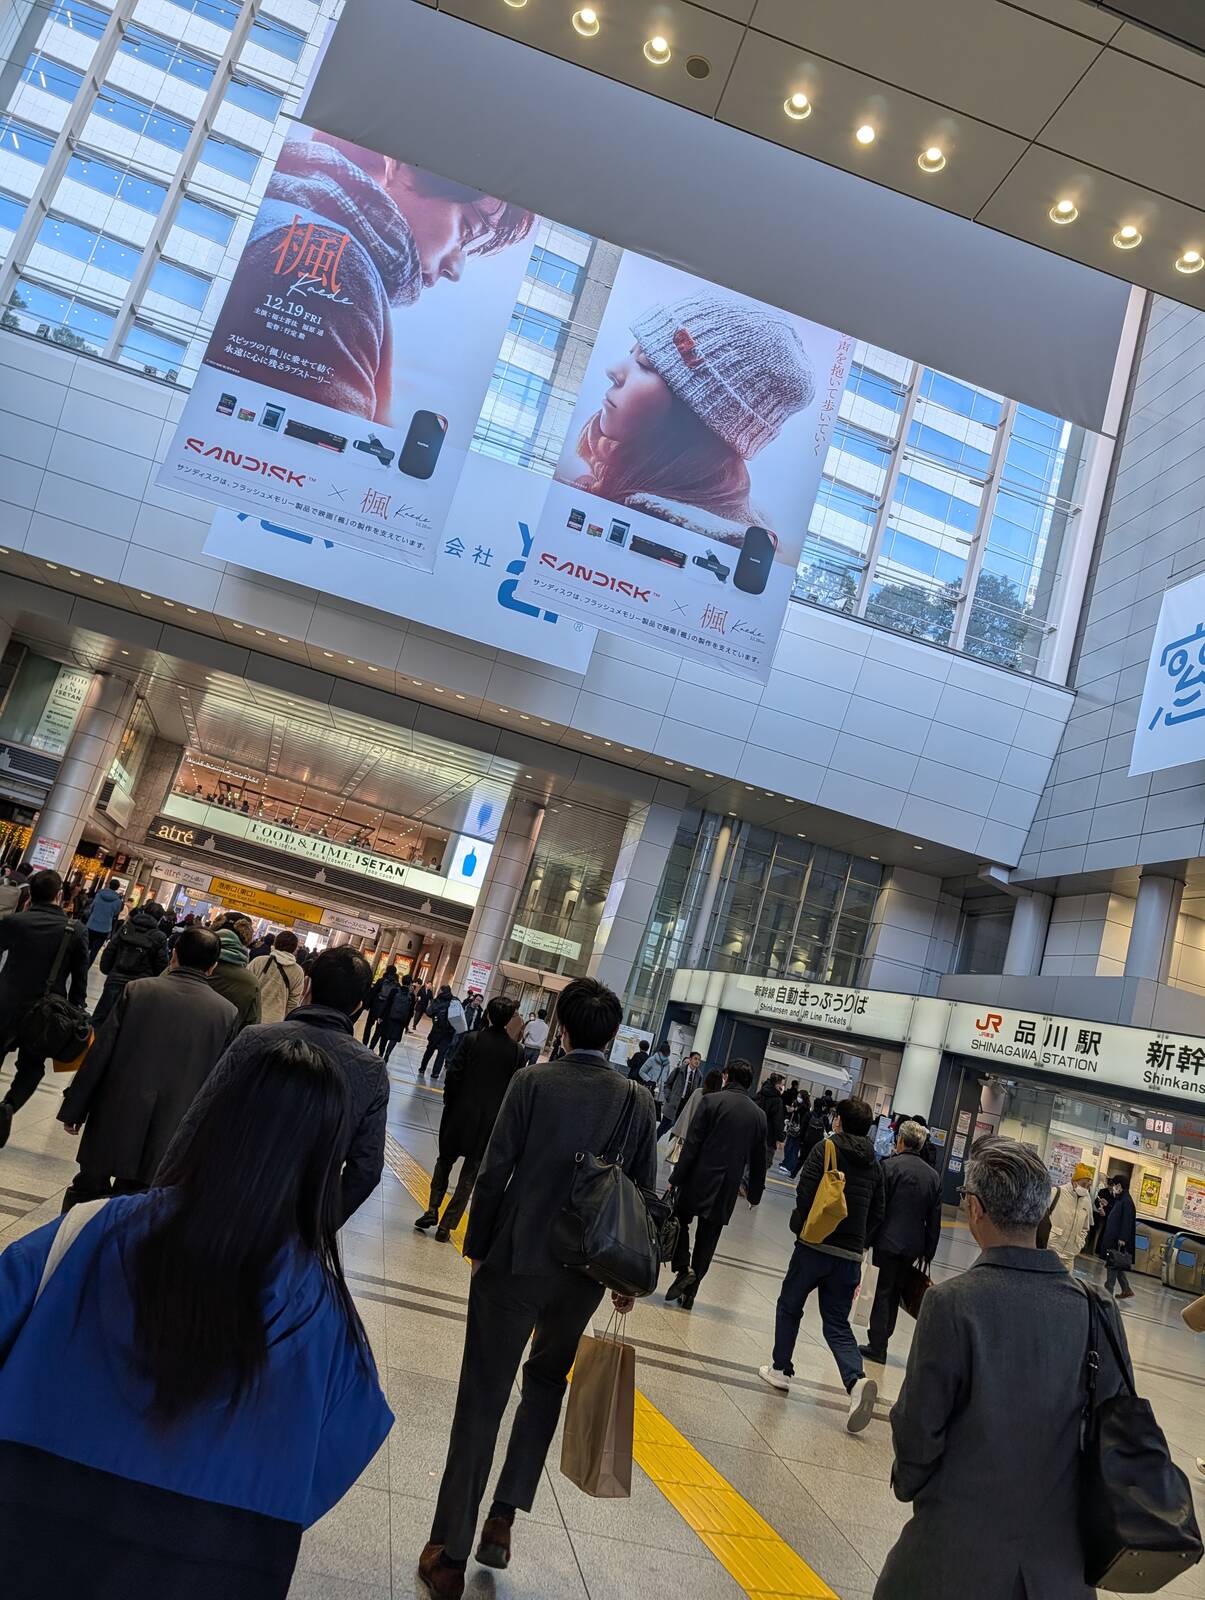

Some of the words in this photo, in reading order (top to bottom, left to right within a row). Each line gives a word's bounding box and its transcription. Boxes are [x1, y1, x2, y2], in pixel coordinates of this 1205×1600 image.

[271, 214, 350, 293] 楓
[263, 294, 304, 317] 12.19
[303, 312, 323, 325] FRI
[184, 437, 306, 487] SANDISK
[360, 487, 392, 521] 楓
[539, 552, 651, 603] SANDISK
[700, 603, 729, 635] 楓
[55, 689, 82, 701] ISETAN
[158, 825, 194, 845] atré
[252, 823, 295, 844] FOOD
[298, 838, 307, 849] &
[310, 842, 354, 862] TIME
[355, 855, 405, 877] ISETAN
[754, 985, 776, 999] 新幹線
[776, 985, 869, 1014] 自動きっぷうりば
[760, 1002, 788, 1016] Shinkansen
[789, 1008, 799, 1018] and
[801, 1010, 809, 1019] JR
[810, 1011, 822, 1021] Line
[824, 1013, 847, 1026] Tickets
[975, 1013, 1003, 1033] JR
[1013, 1019, 1102, 1057] 品川駅
[970, 1039, 1037, 1061] SHINAGAWA
[1042, 1052, 1098, 1073] STATION
[1146, 1040, 1205, 1076] 新幹
